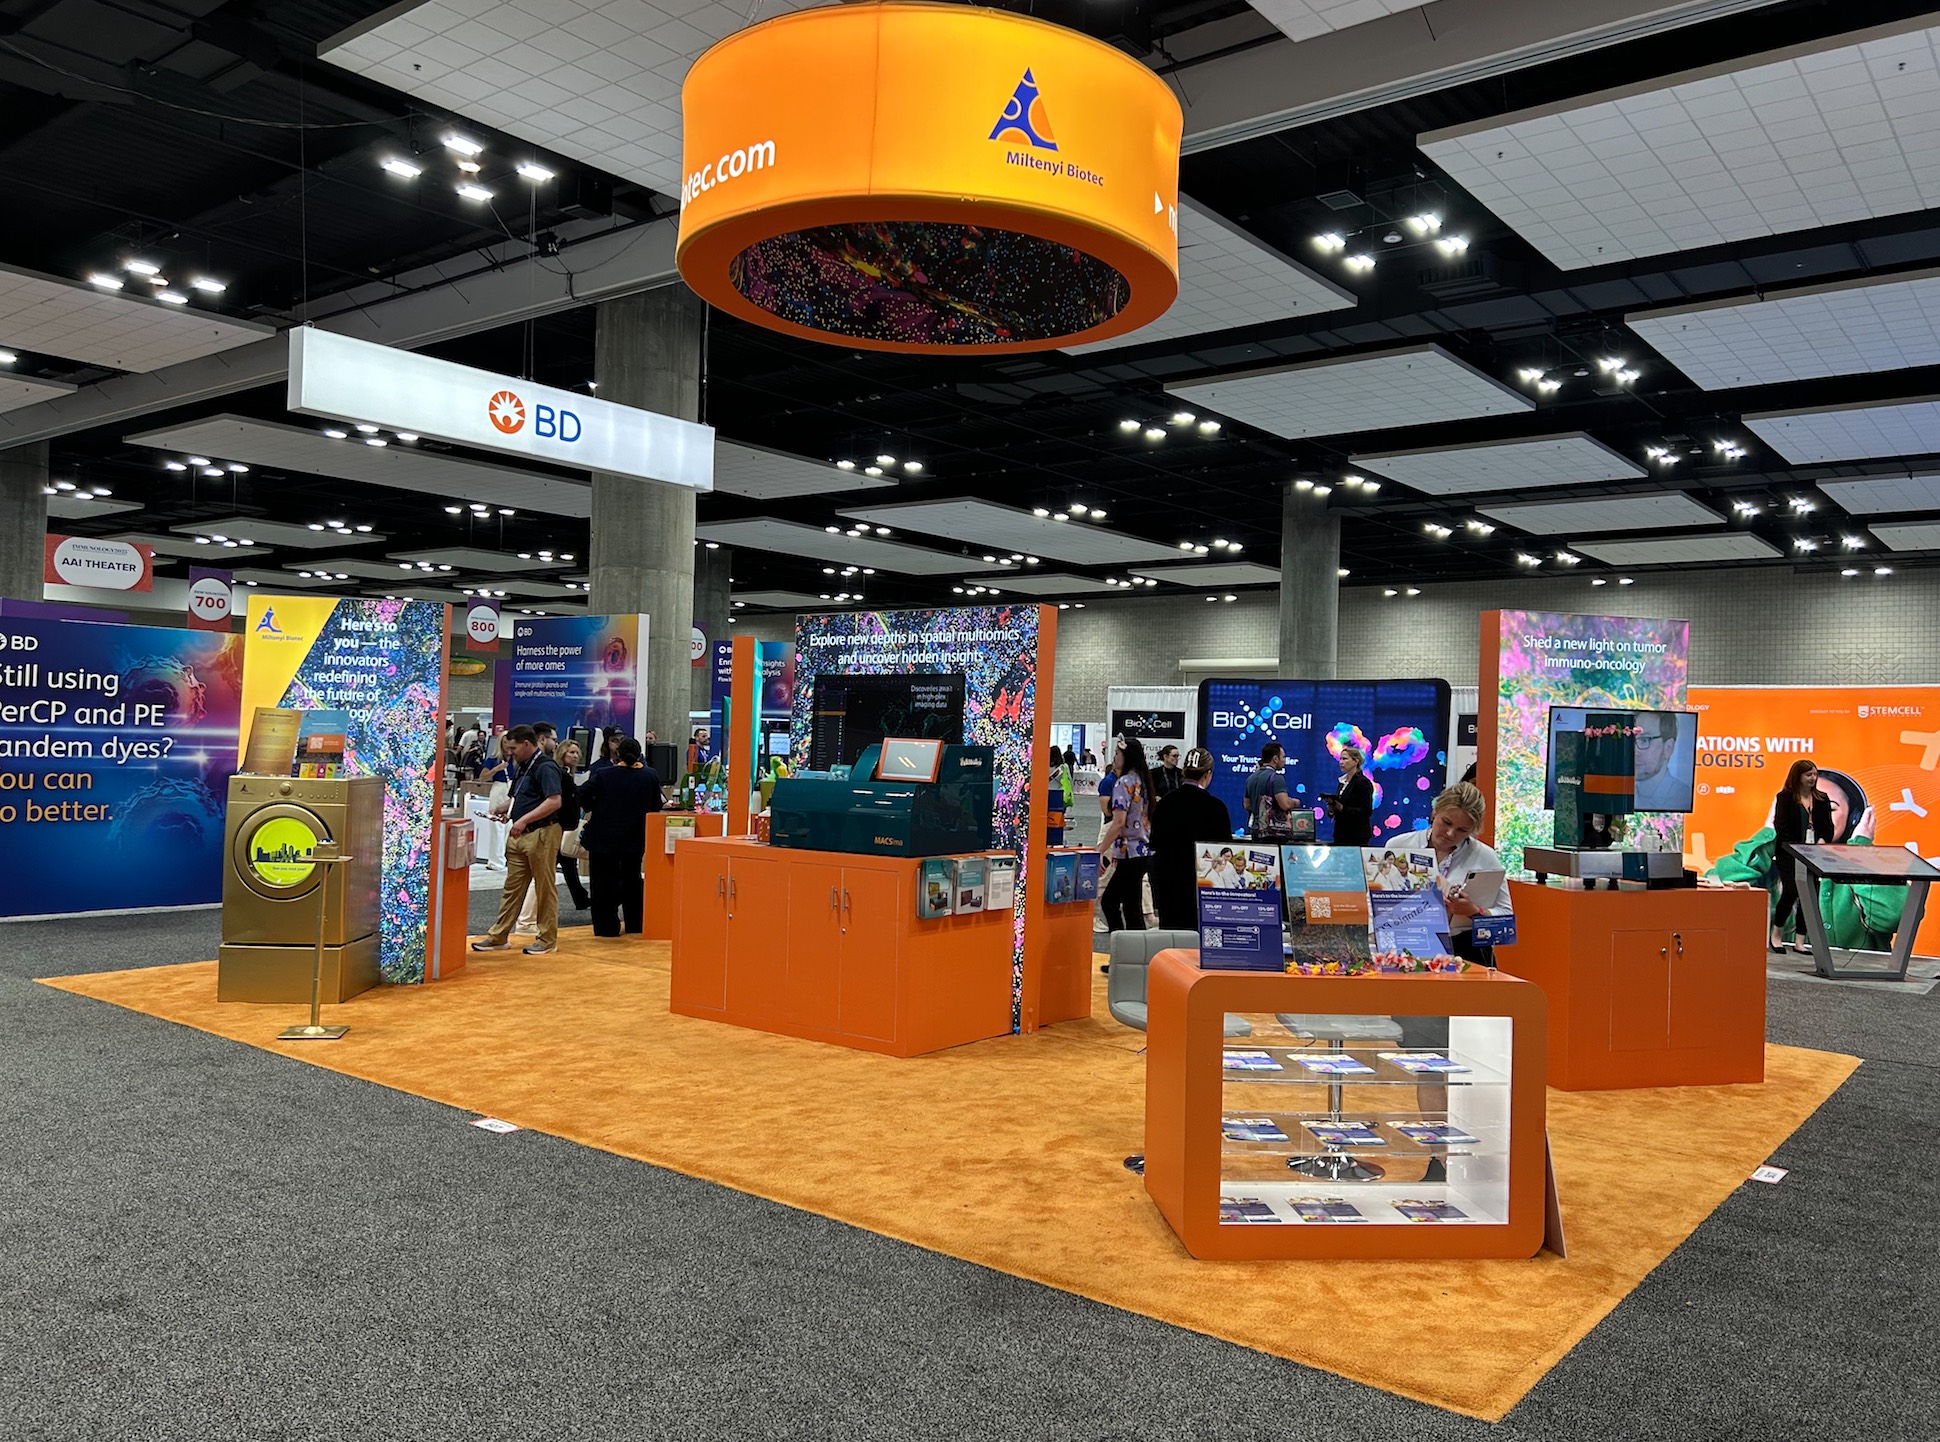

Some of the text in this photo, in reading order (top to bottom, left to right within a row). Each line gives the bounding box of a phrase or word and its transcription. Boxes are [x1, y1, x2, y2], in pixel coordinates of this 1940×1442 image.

[1006, 151, 1104, 187] Miltenyi Biotec
[535, 404, 582, 443] BD
[62, 557, 137, 572] AAI THEATER
[195, 596, 226, 609] 700
[341, 618, 398, 632] Here's to
[472, 621, 496, 632] 800
[11, 636, 38, 651] BD
[334, 637, 359, 651] you
[379, 637, 400, 650] the
[810, 629, 1020, 649] Explore new depths in spatial multiomics
[1524, 634, 1666, 653] Shed a new light on tumor
[516, 644, 582, 658] Harness the power
[838, 650, 984, 666] and uncover hidden insights
[324, 653, 390, 667] innovators
[516, 660, 566, 671] of more omes
[1544, 655, 1646, 674] immuno-oncology
[48, 668, 120, 697] using
[314, 670, 377, 686] redefining
[304, 688, 382, 701] the future of
[0, 700, 166, 726] erCP and PE
[0, 734, 174, 765] andem dyes?
[1765, 738, 1814, 753] WITH
[1222, 754, 1238, 762] Your
[0, 772, 92, 790] ou can
[0, 798, 114, 823] o better.
